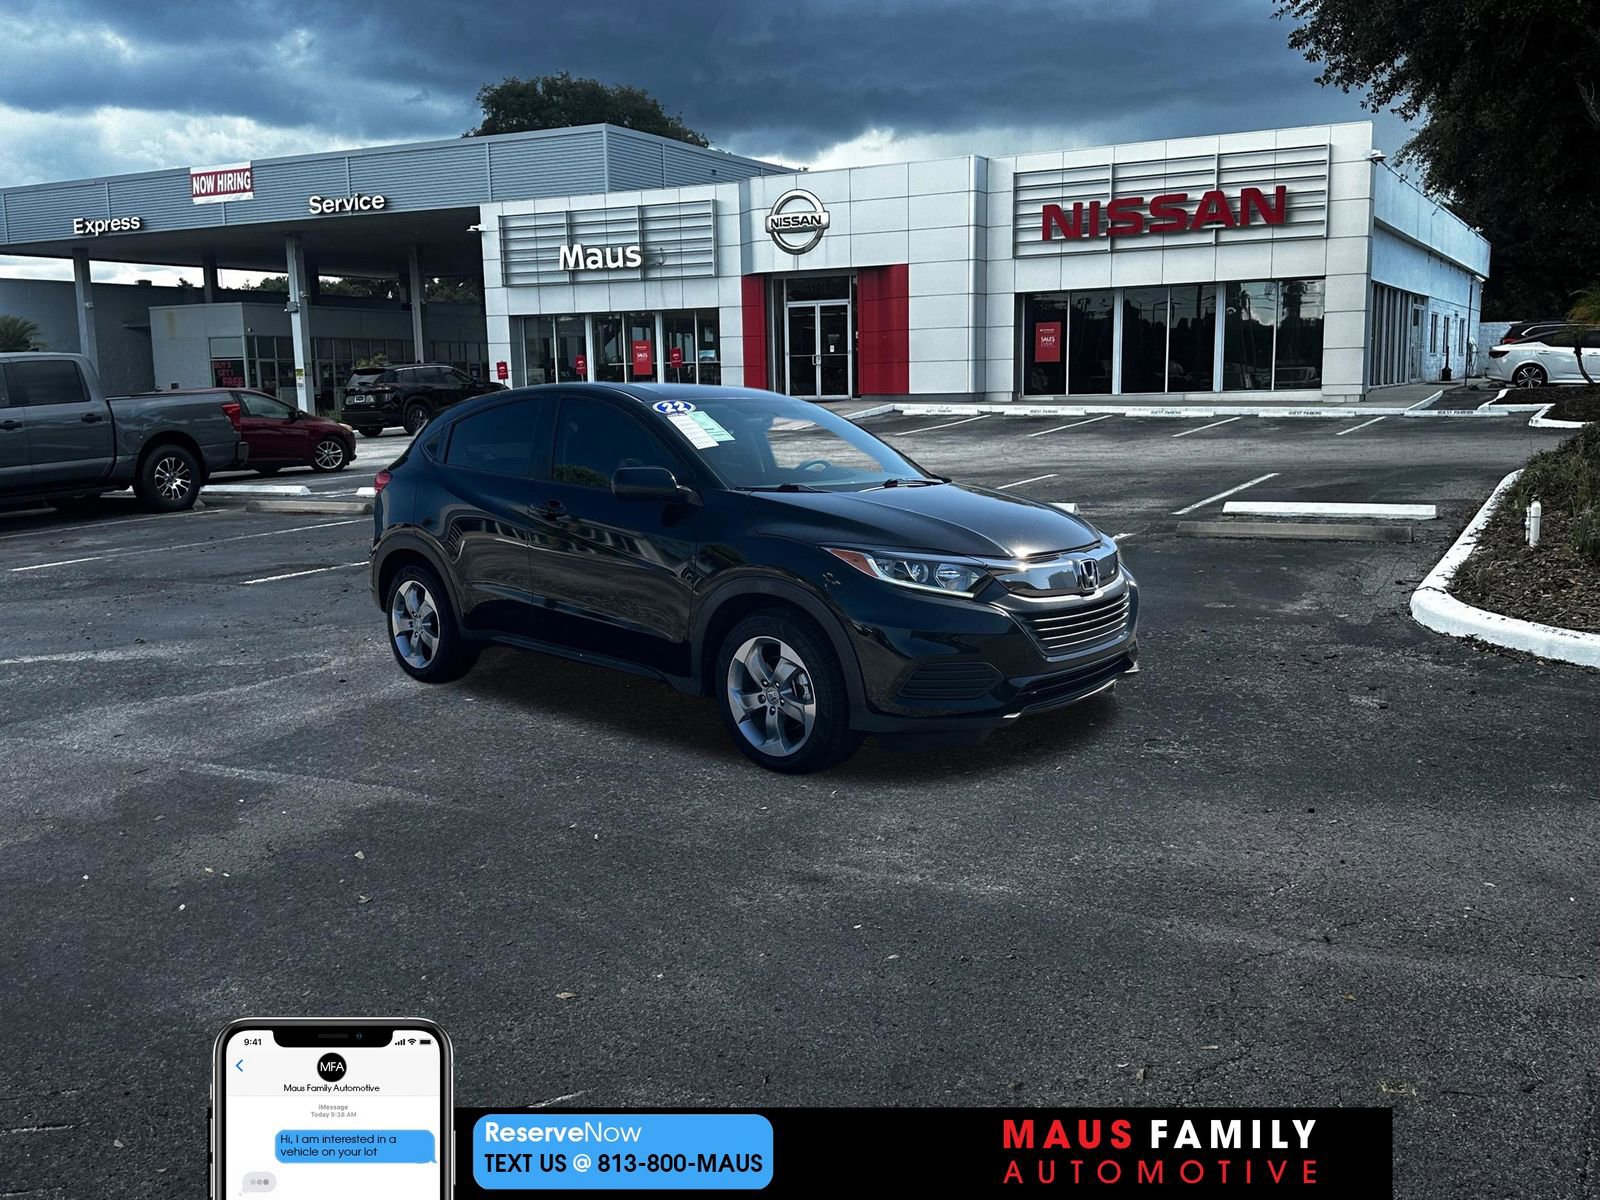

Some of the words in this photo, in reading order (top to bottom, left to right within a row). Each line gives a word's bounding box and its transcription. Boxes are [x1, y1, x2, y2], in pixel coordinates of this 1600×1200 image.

[192, 174, 215, 195] NOW
[217, 170, 251, 192] HIRING
[309, 193, 385, 214] Service
[1042, 185, 1287, 241] NISSAN
[73, 215, 141, 236] Express
[771, 215, 822, 228] NISSAN
[559, 243, 642, 270] Maus
[662, 400, 688, 412] 22
